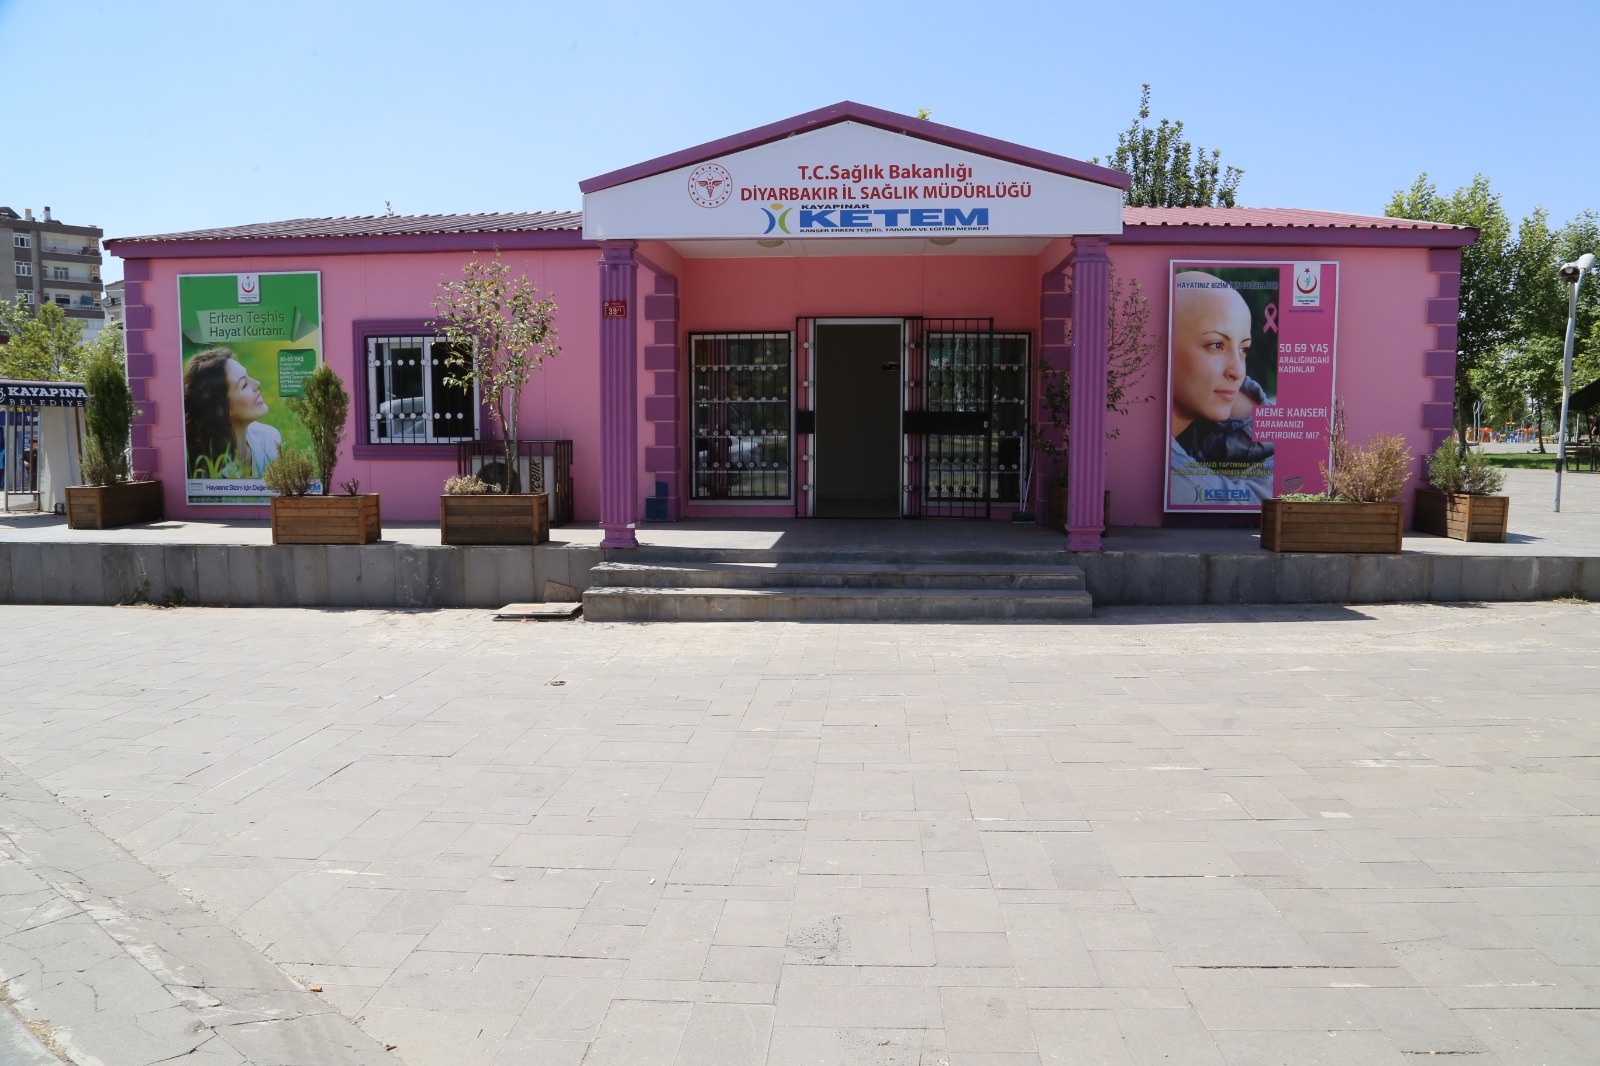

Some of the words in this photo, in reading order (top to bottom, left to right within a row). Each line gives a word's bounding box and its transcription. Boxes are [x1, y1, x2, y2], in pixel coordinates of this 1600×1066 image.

[798, 164, 884, 183] T.C.Sağlık
[889, 163, 973, 182] Bakanlığı
[741, 184, 838, 201] DİYARBAKIR
[842, 184, 856, 200] İL
[860, 183, 918, 200] SAĞLIK
[923, 181, 1032, 199] MÜDÜRLÜĞÜ
[800, 208, 989, 227] KETEM
[1177, 281, 1209, 289] HAYATINIZ
[1211, 280, 1229, 289] BİZİM
[209, 312, 243, 324] Erken
[246, 310, 285, 325] Teşhis
[210, 326, 242, 339] Hayat
[243, 325, 286, 337] Kurtarır.
[1279, 343, 1292, 353] 50
[1294, 343, 1307, 353] 69
[1310, 343, 1329, 355] YAŞ
[1279, 356, 1330, 364] ARALIĞINDAKİ
[8, 386, 88, 398] KAYAPINA
[9, 398, 83, 407] BELEDİYE
[1255, 407, 1284, 417] MEME
[1287, 406, 1328, 418] KANSERİ
[1255, 420, 1304, 429] TARAMANIZI
[1254, 431, 1303, 439] YAPTIRDINIZ
[1305, 431, 1320, 439] MI?
[1204, 489, 1251, 499] KETEM
